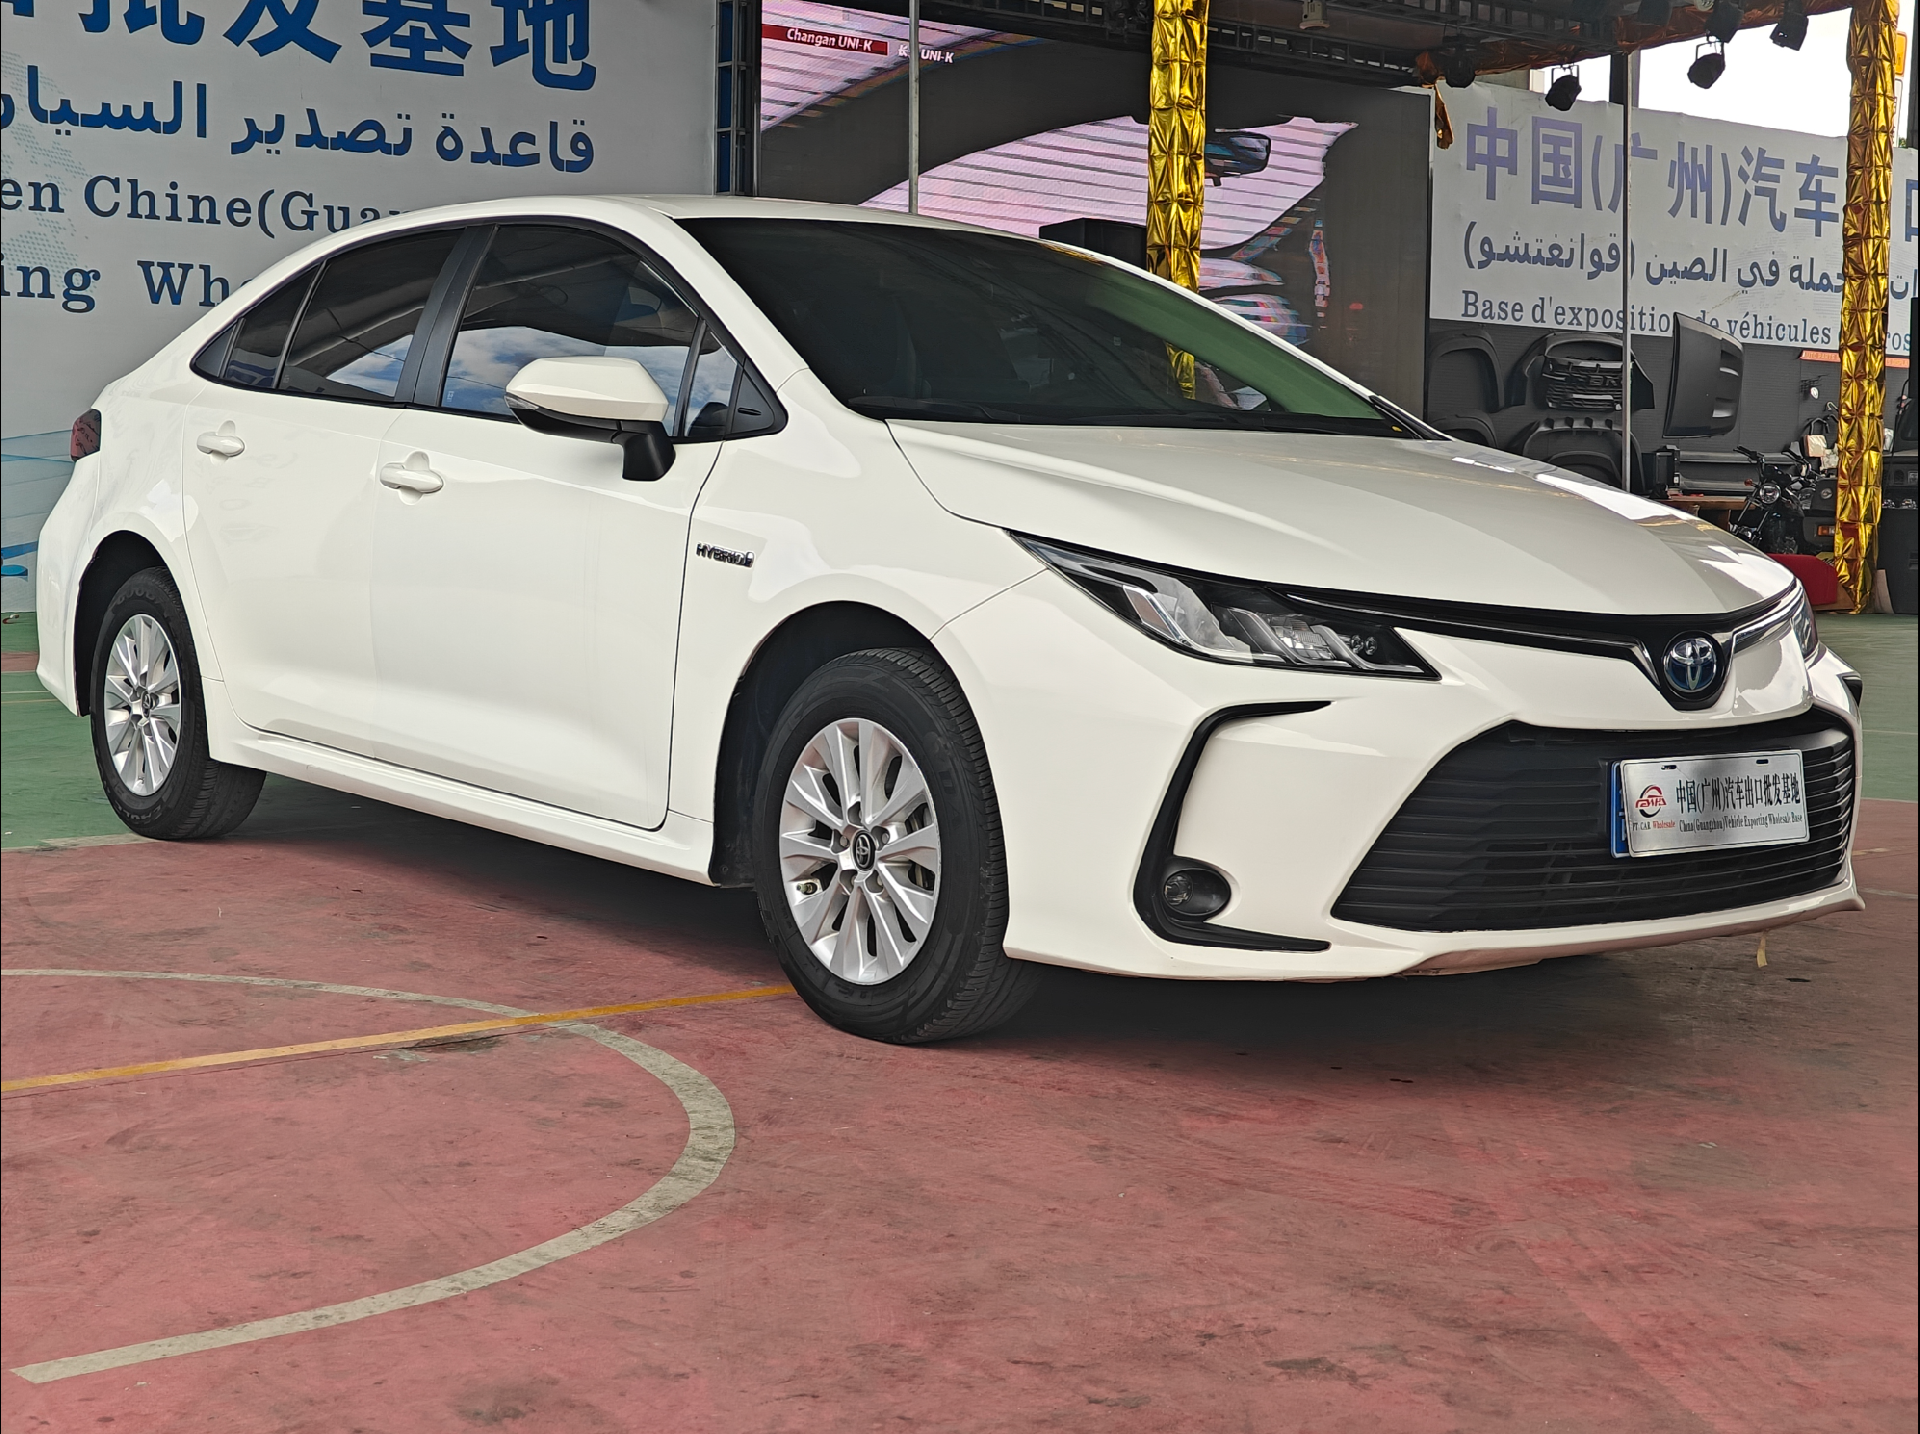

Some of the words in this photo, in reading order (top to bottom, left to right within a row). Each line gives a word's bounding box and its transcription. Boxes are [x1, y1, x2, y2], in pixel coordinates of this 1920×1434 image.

[786, 28, 836, 47] Changan
[837, 36, 873, 51] UNI-K
[920, 48, 954, 63] UNI-K
[231, 107, 413, 156] تصدير
[436, 112, 595, 173] قاعدة
[1645, 247, 1728, 286] الصين
[1737, 251, 1780, 295] في
[1461, 290, 1524, 321] Base
[1531, 296, 1672, 333] d'expositio
[1727, 311, 1832, 345] véhicules
[696, 543, 746, 566] HYBRID
[1676, 772, 1801, 814] 中国(广州)汽车出口批发基地
[1743, 813, 1768, 829] Exporting
